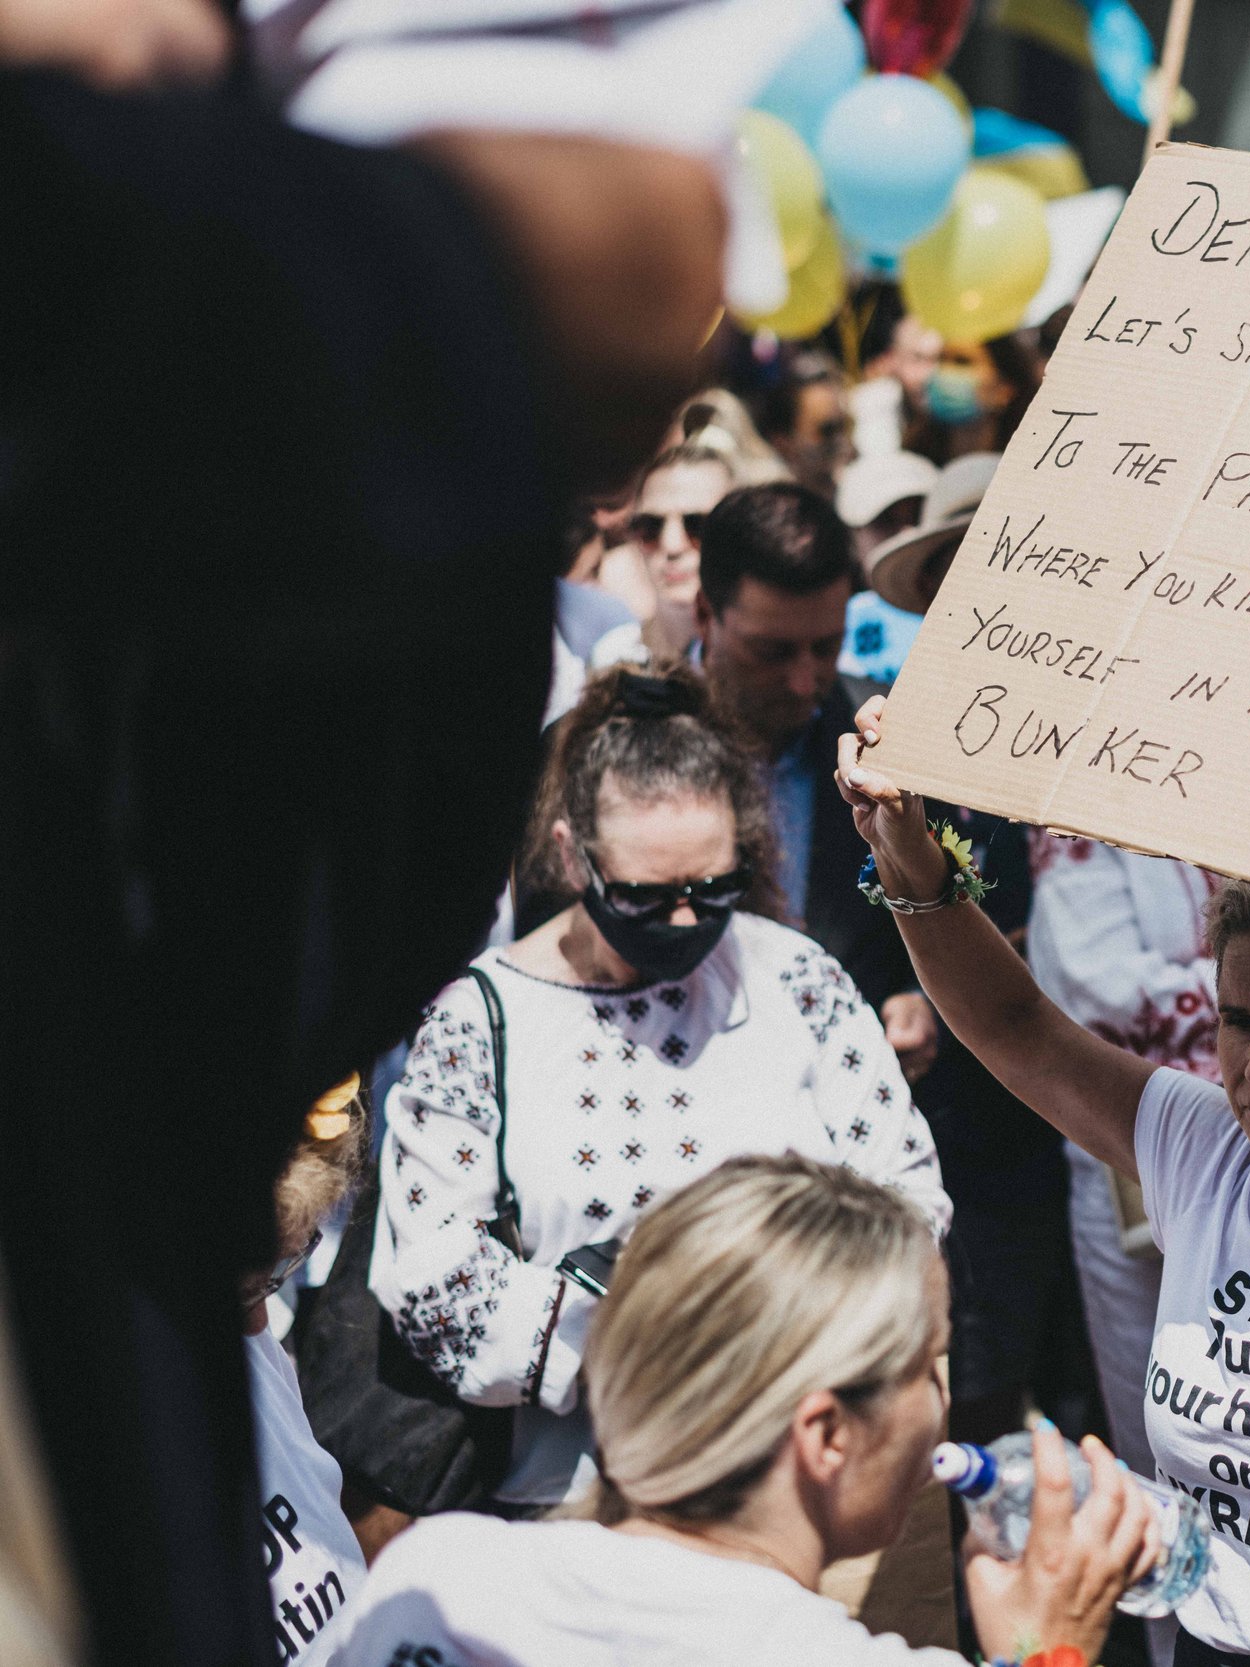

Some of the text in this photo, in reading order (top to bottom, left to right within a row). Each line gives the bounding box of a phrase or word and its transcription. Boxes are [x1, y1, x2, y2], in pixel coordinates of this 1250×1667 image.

[1084, 296, 1198, 355] LET'S
[1034, 409, 1098, 470] TO
[1112, 441, 1178, 486] THE
[987, 514, 1110, 588] WHERE
[1124, 549, 1196, 606] YOU
[961, 603, 1141, 685] YOURSELF
[1170, 671, 1230, 702] IN
[954, 684, 1205, 799] BUNKER
